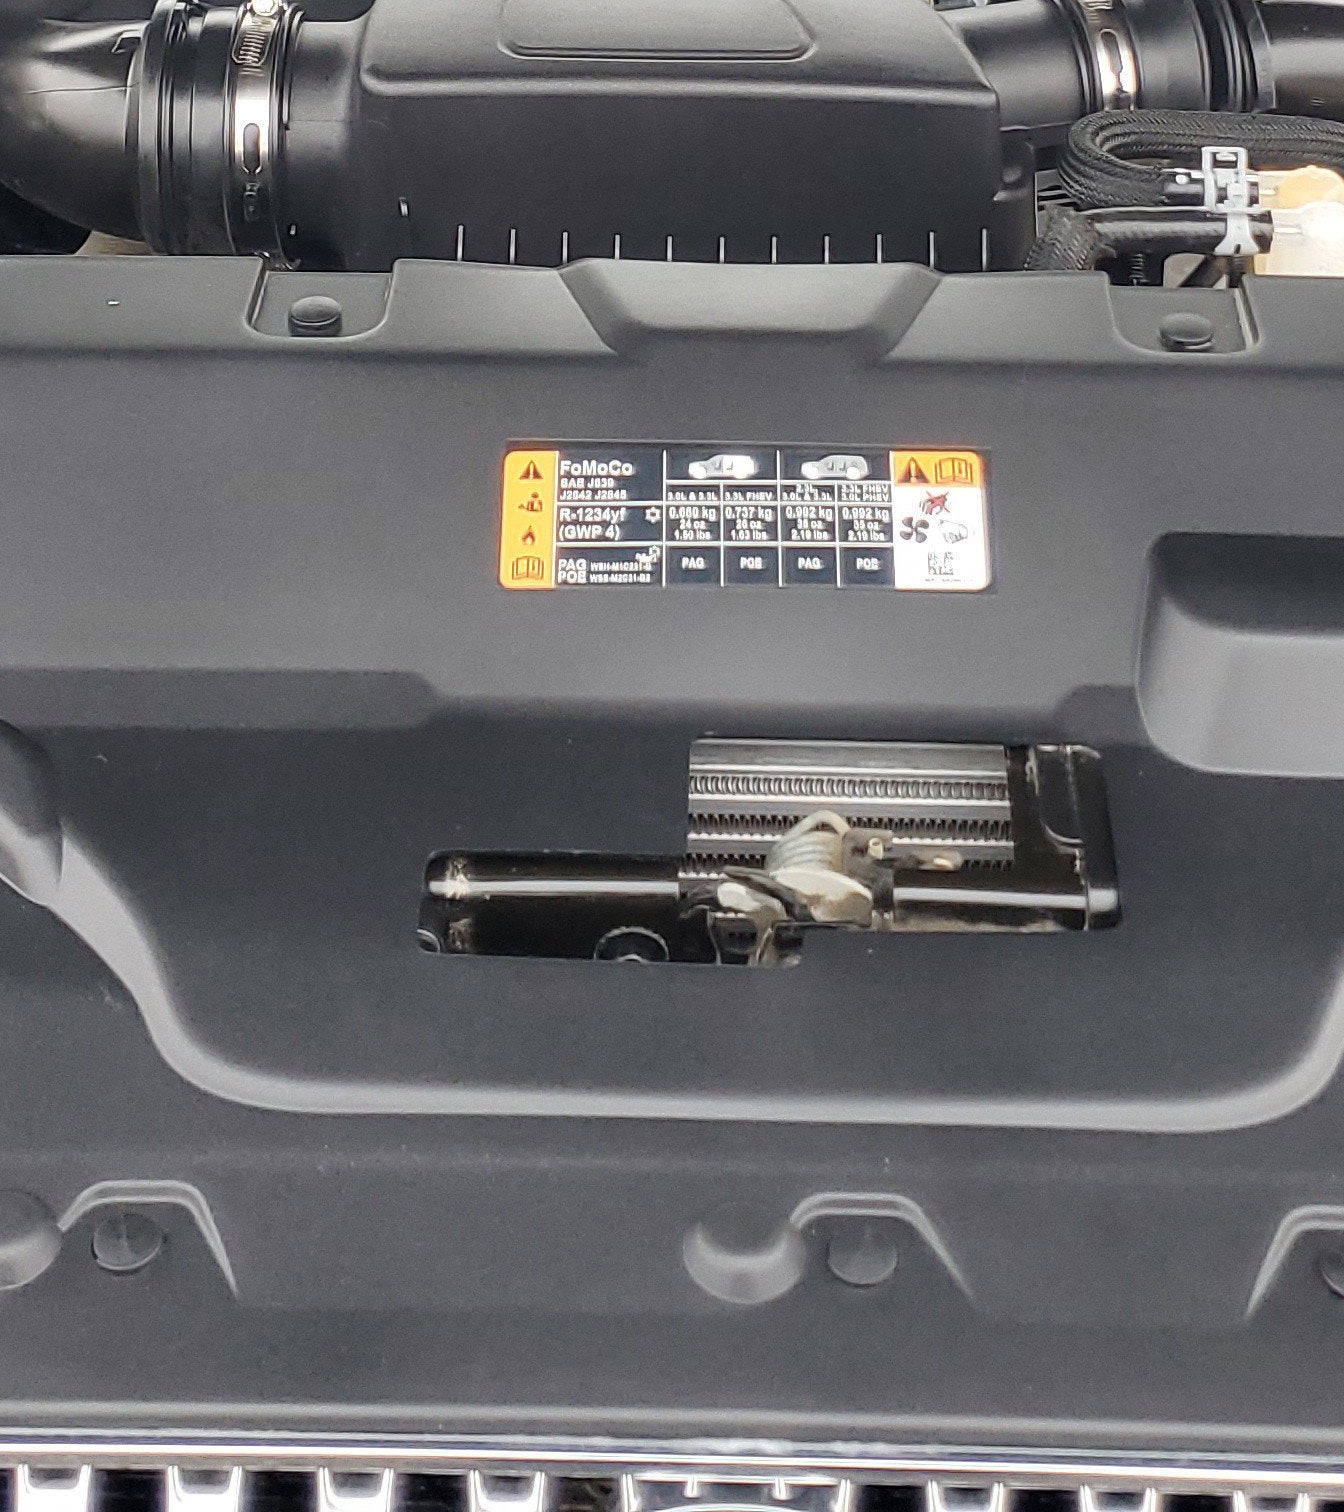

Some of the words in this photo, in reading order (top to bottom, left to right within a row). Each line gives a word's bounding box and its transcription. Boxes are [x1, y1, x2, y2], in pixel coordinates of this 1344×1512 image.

[560, 460, 633, 476] FoMoCo
[559, 507, 626, 524] R-1234yf
[702, 507, 716, 521] kg
[725, 507, 755, 519] 0.737
[758, 507, 773, 521] kg
[819, 506, 832, 521] kg
[875, 508, 889, 523] kg
[559, 525, 602, 541] (GWP
[605, 525, 620, 541] 4)
[558, 559, 587, 570] PAG
[682, 557, 705, 569] PAG
[740, 557, 762, 569] POE
[798, 557, 821, 569] PAG
[856, 557, 879, 569] POE
[558, 571, 587, 583] POE
